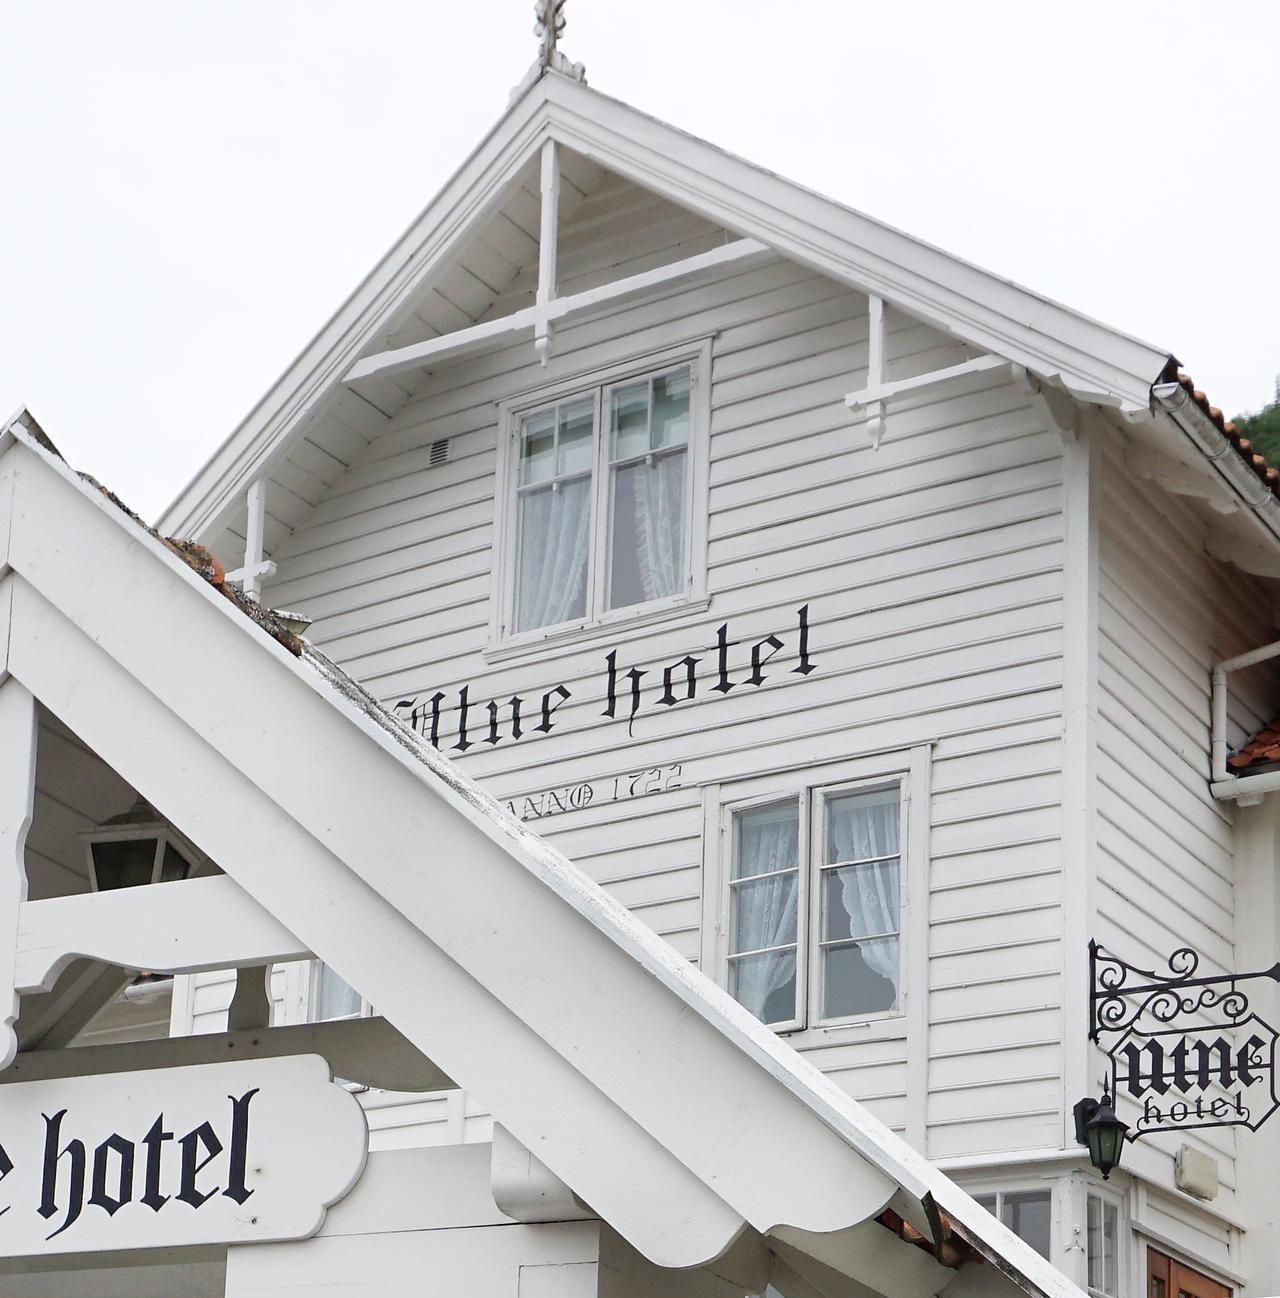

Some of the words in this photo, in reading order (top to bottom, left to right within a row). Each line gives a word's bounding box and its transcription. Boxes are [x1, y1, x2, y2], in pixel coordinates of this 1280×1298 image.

[600, 603, 818, 738] hotel
[612, 764, 682, 802] 1722
[1144, 1091, 1245, 1124] hotel
[37, 1087, 260, 1240] hotel
